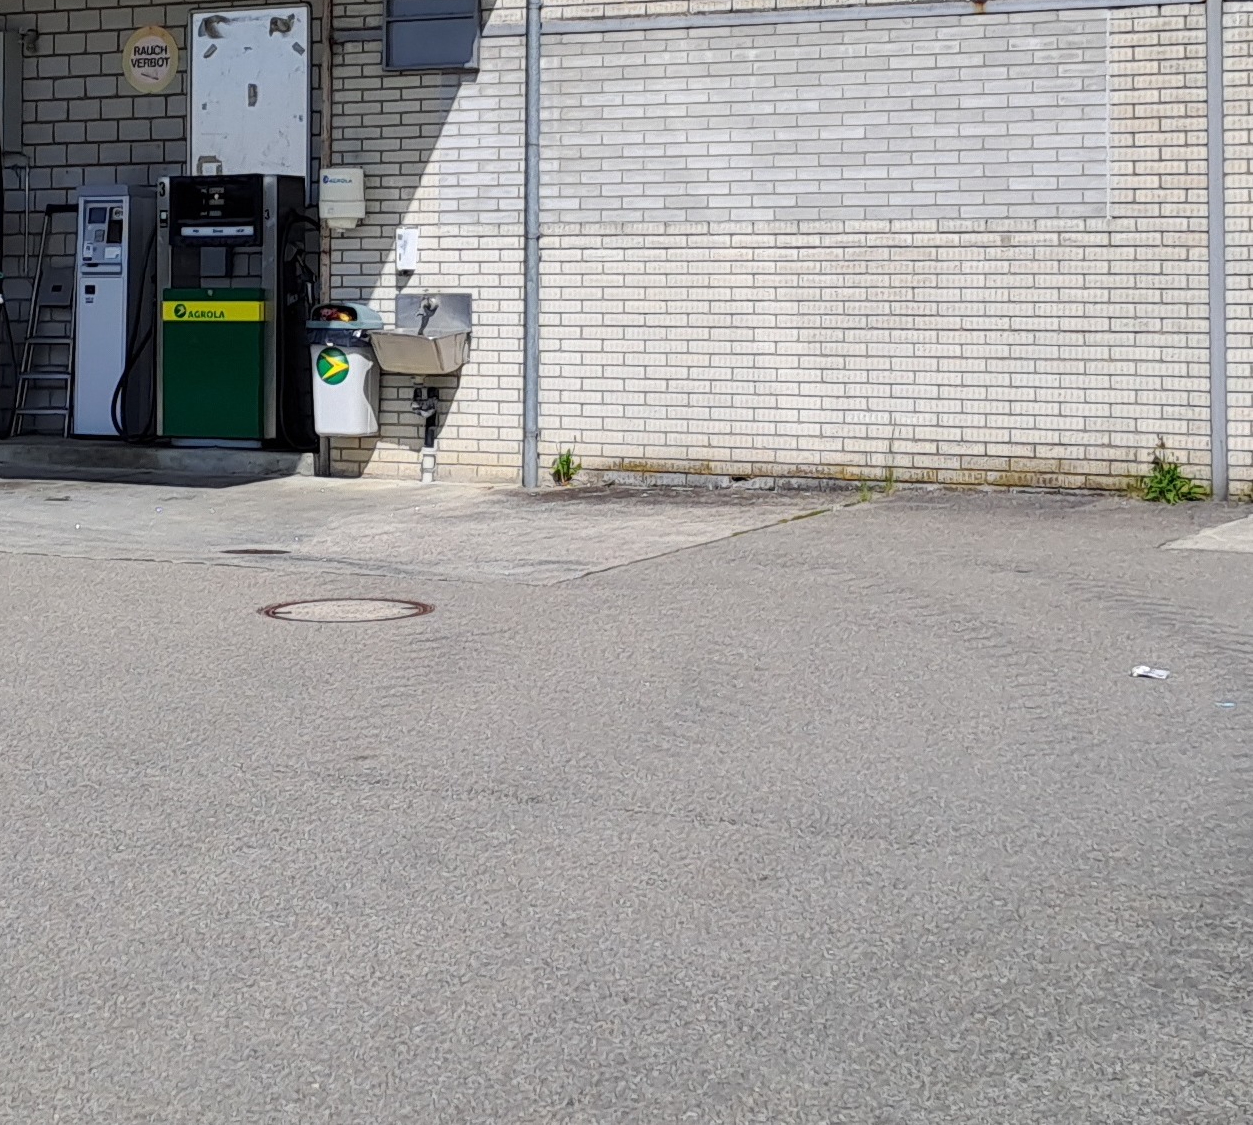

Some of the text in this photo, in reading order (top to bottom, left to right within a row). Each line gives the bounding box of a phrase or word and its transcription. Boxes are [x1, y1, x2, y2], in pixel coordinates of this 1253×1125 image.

[133, 45, 168, 56] RAUCH
[131, 57, 170, 68] VERBOT
[159, 181, 166, 197] 3
[265, 209, 271, 220] 3
[188, 310, 225, 319] AGROLA
